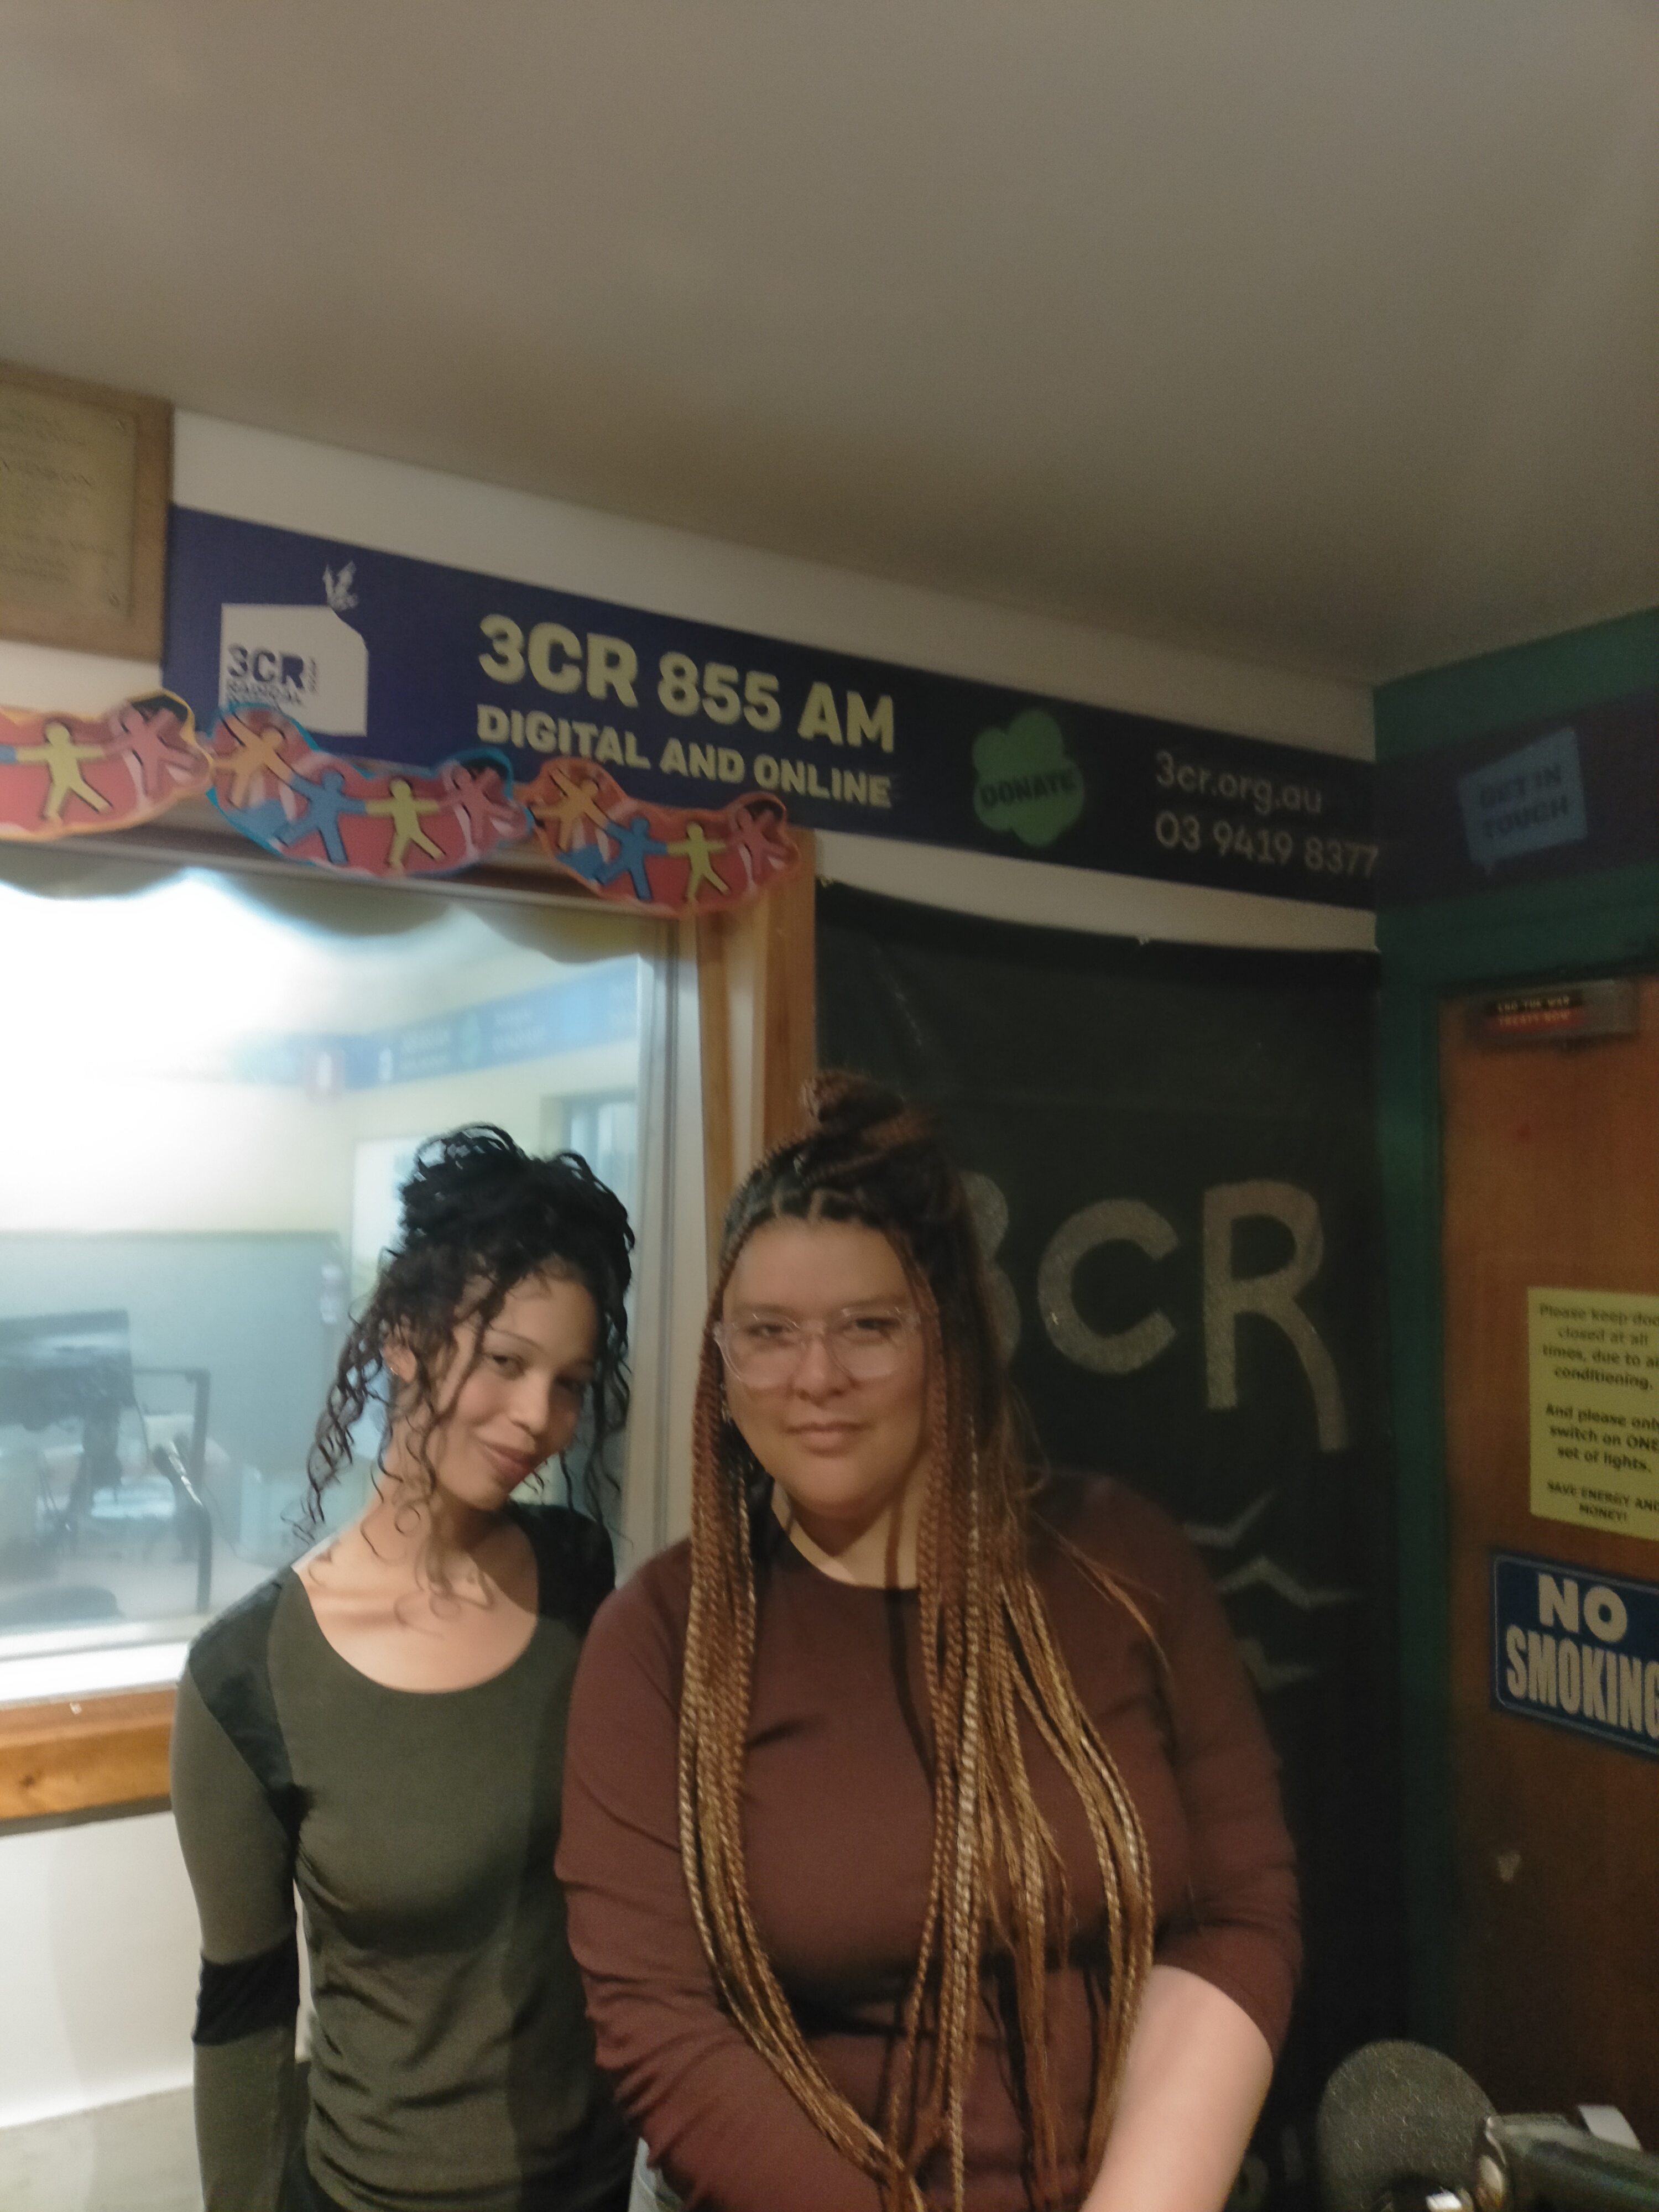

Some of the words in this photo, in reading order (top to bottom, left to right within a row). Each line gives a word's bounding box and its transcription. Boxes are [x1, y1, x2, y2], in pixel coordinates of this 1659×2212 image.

[478, 614, 638, 708] 3CR
[657, 652, 781, 732] 855
[797, 682, 894, 753] AM
[477, 705, 651, 769] DIGITAL
[659, 738, 745, 783] AND
[754, 754, 893, 808] ONLINE
[980, 770, 1076, 808] DONATE
[1156, 749, 1322, 816] 3cr.org.au
[1155, 810, 1201, 852] 03
[1213, 820, 1293, 866] 9419
[1305, 836, 1379, 878] 8377
[1540, 1303, 1586, 1319] Please
[1592, 1308, 1627, 1326] keep
[1558, 1326, 1604, 1340] closed
[1610, 1331, 1624, 1344] at
[1630, 1332, 1648, 1345] all
[1592, 1349, 1620, 1364] due
[1625, 1352, 1640, 1366] to
[1546, 1403, 1573, 1417] And
[1578, 1408, 1626, 1426] please
[1550, 1425, 1597, 1441] switch
[1603, 1433, 1621, 1445] on
[1626, 1434, 1659, 1451] ONE
[1557, 1446, 1579, 1459] set
[1584, 1449, 1599, 1462] of
[1547, 1480, 1577, 1496] SAVE
[1580, 1486, 1630, 1507] ENERGY
[1538, 1573, 1627, 1643] NO
